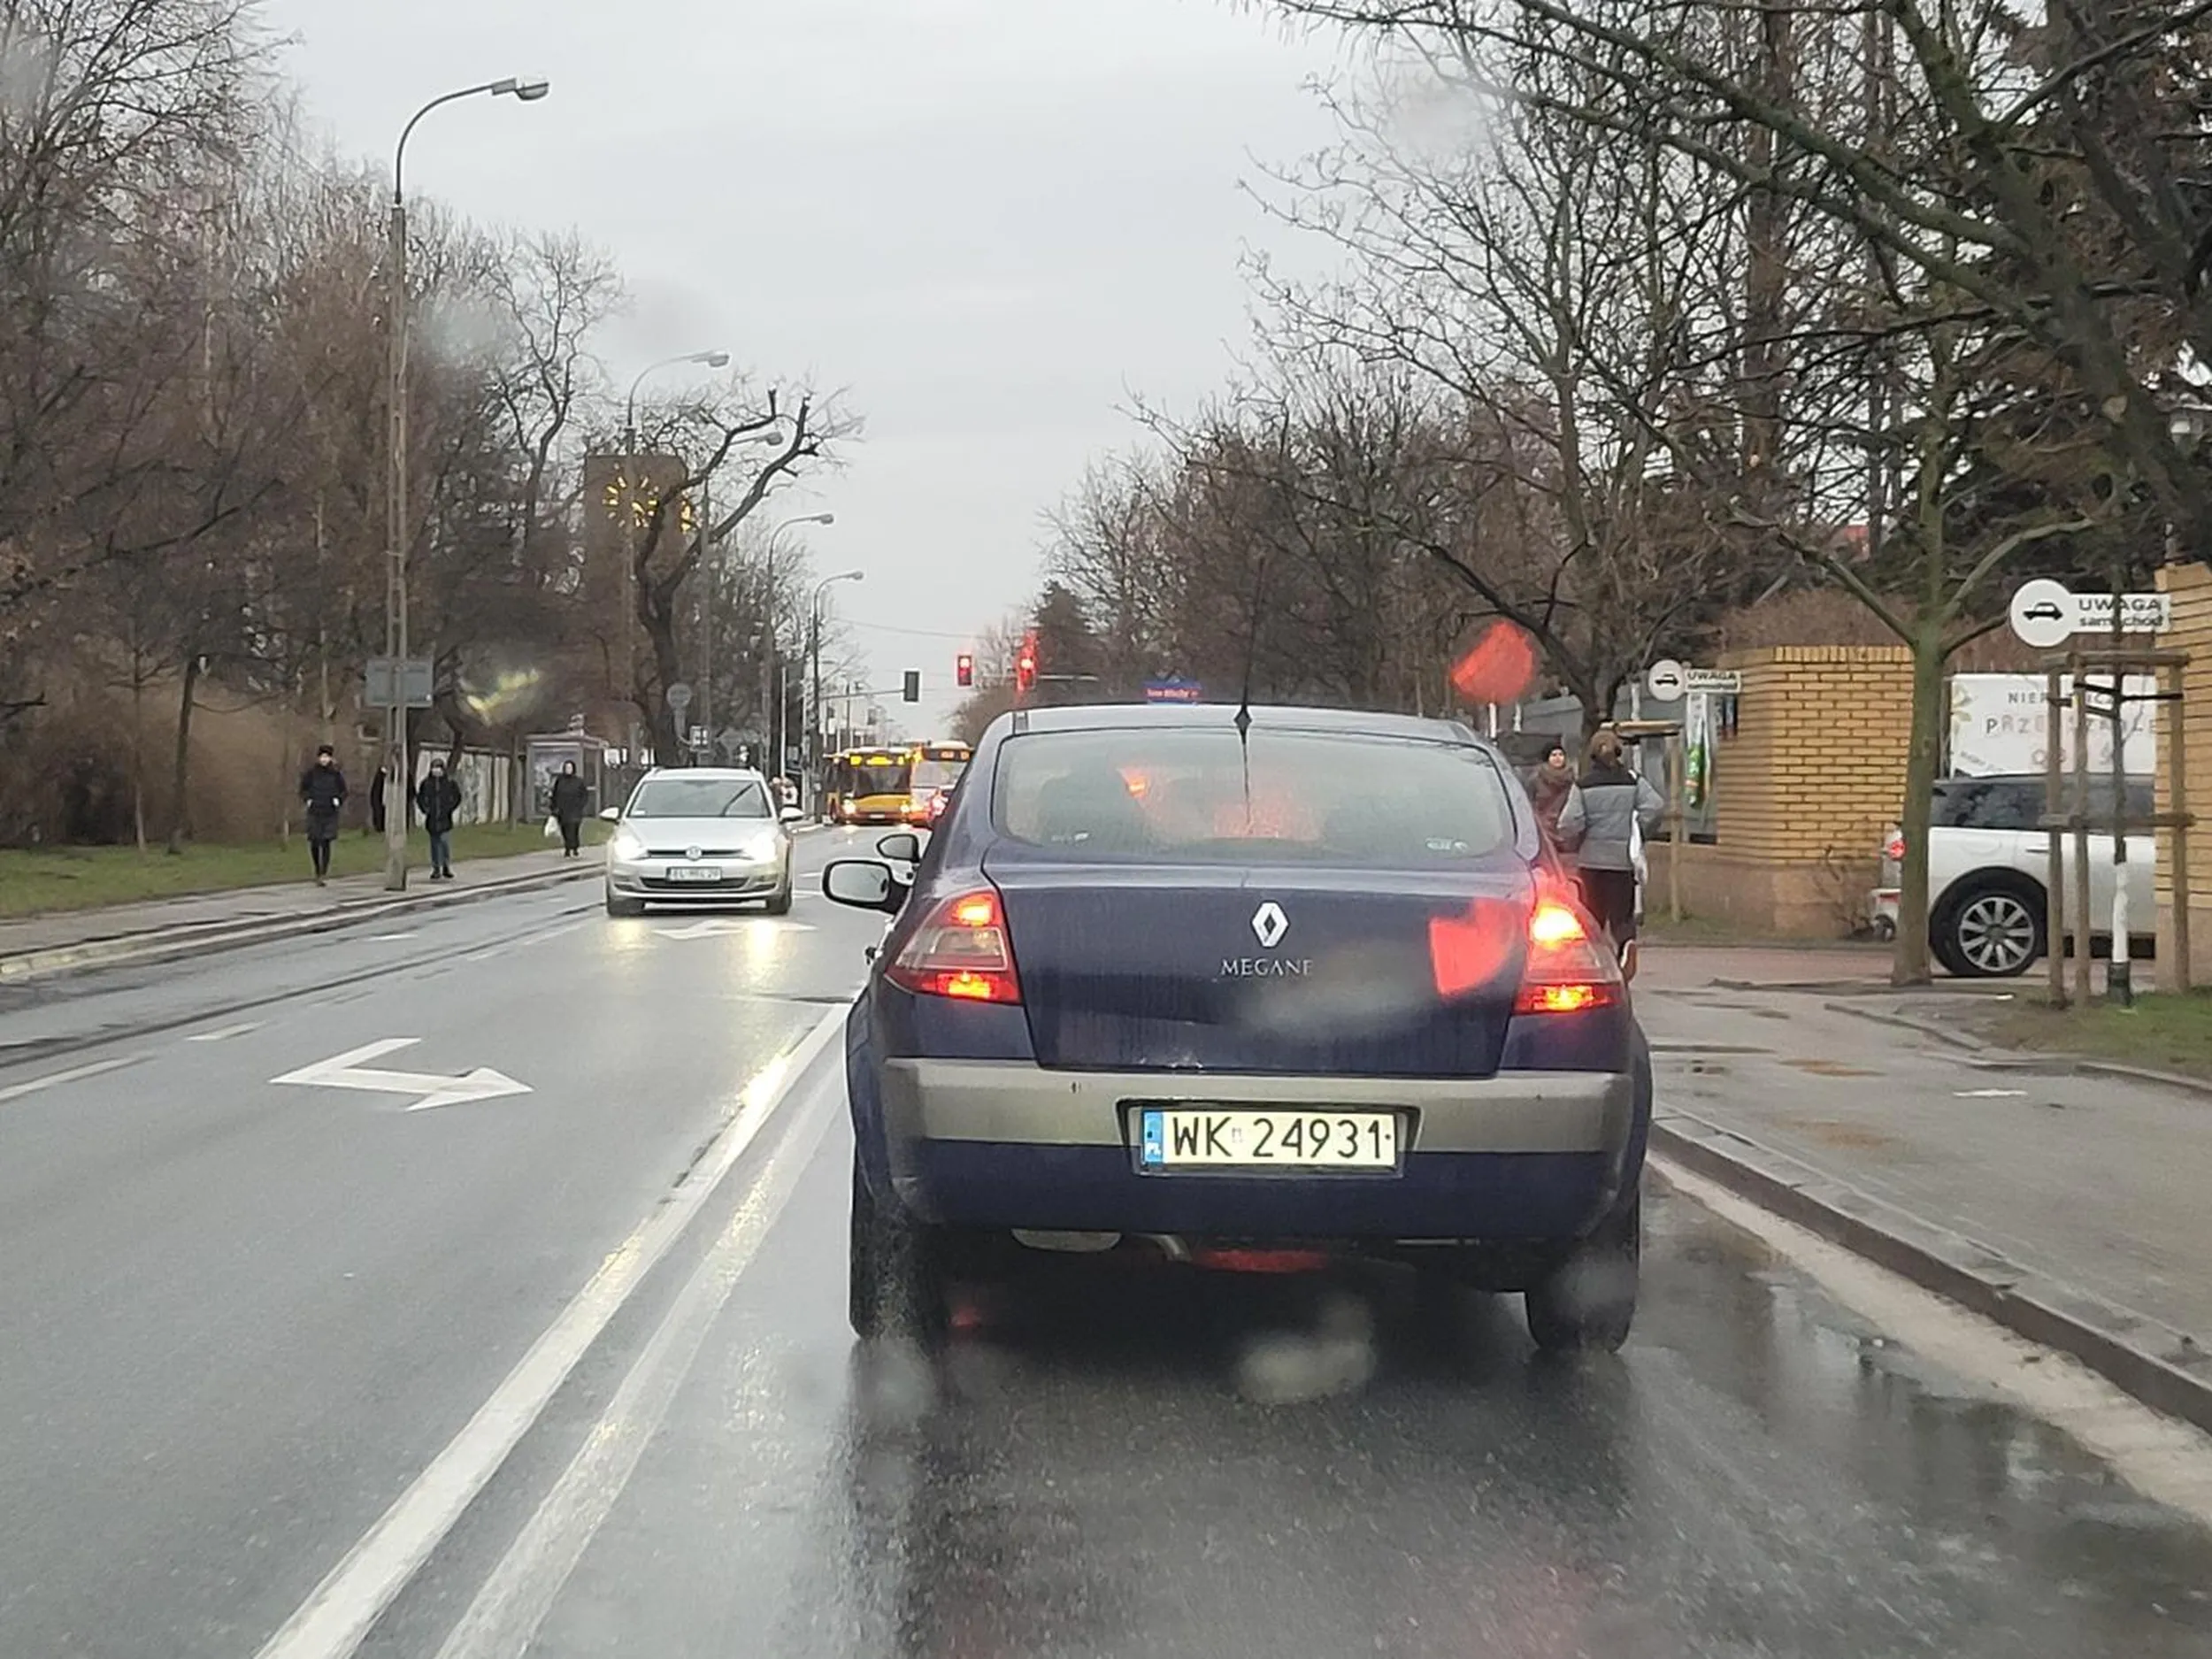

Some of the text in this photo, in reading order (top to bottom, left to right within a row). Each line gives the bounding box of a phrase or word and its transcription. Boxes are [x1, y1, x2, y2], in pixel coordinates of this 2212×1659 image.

[1221, 957, 1313, 977] MEGANE
[1173, 1117, 1380, 1159] WK 24931
